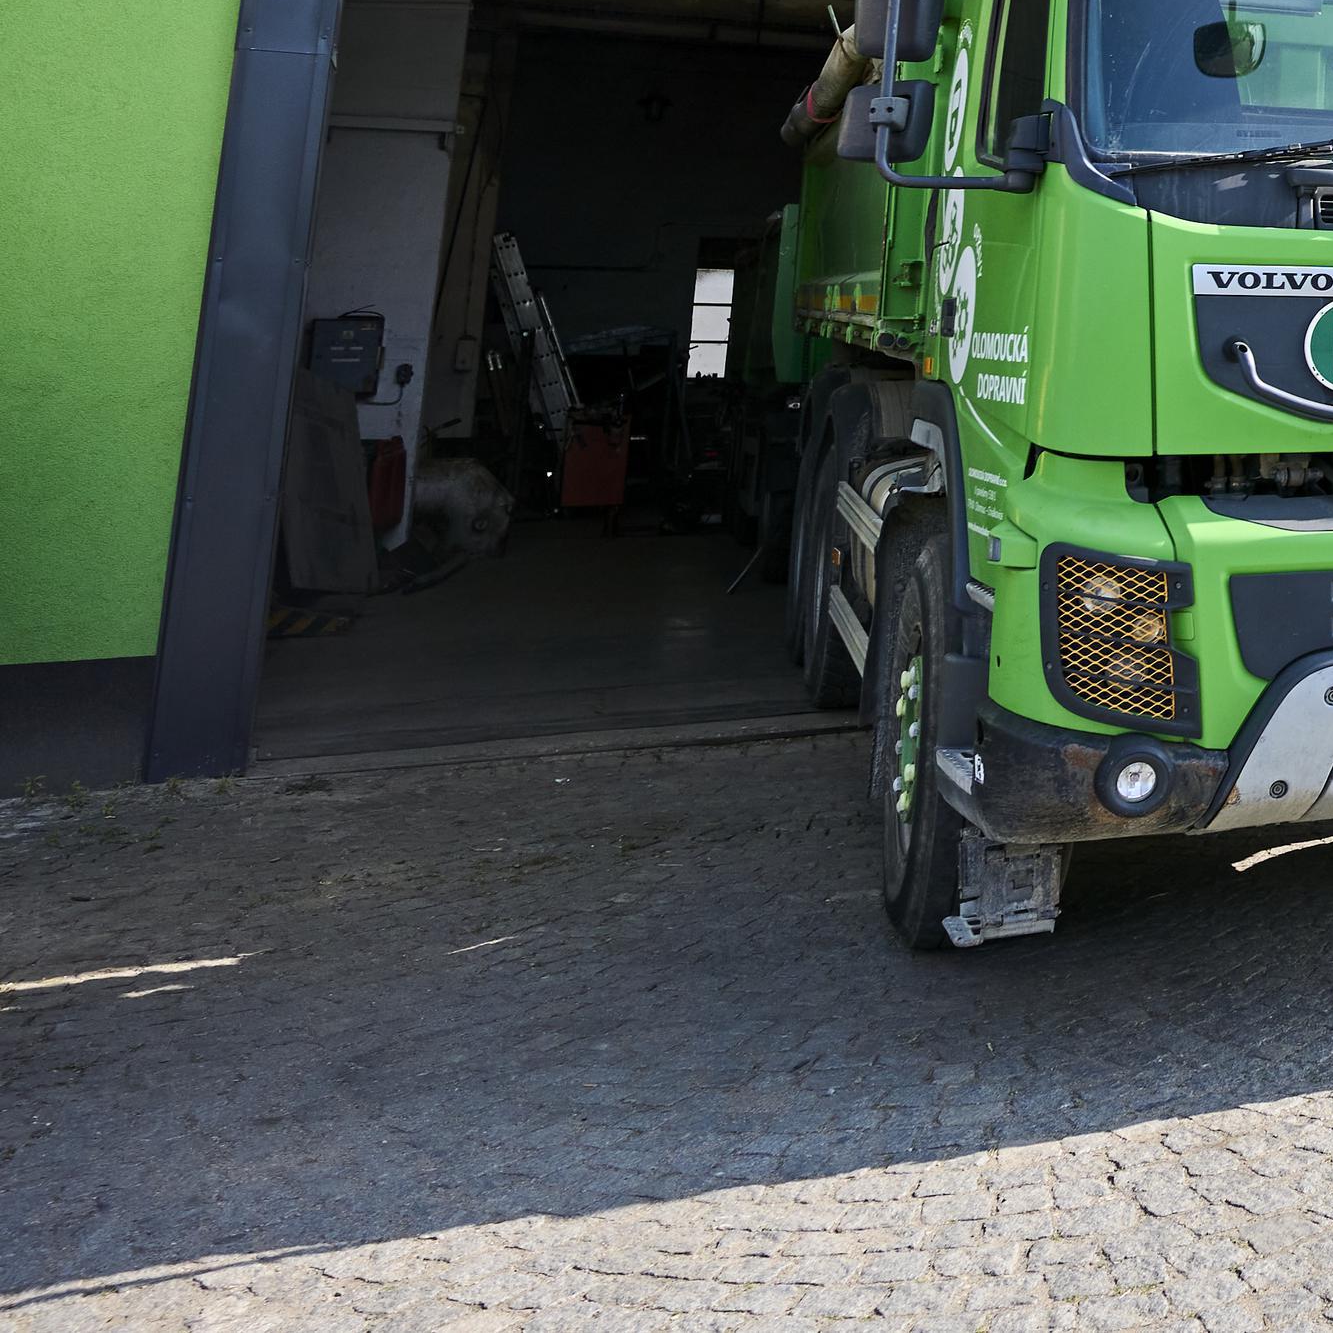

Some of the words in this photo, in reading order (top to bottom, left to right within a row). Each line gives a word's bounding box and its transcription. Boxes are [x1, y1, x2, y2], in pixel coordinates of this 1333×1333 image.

[1207, 271, 1333, 291] VOLVO
[972, 326, 1028, 363] OLOMOUCKÁ
[977, 370, 1027, 405] DOPRAVNÍ
